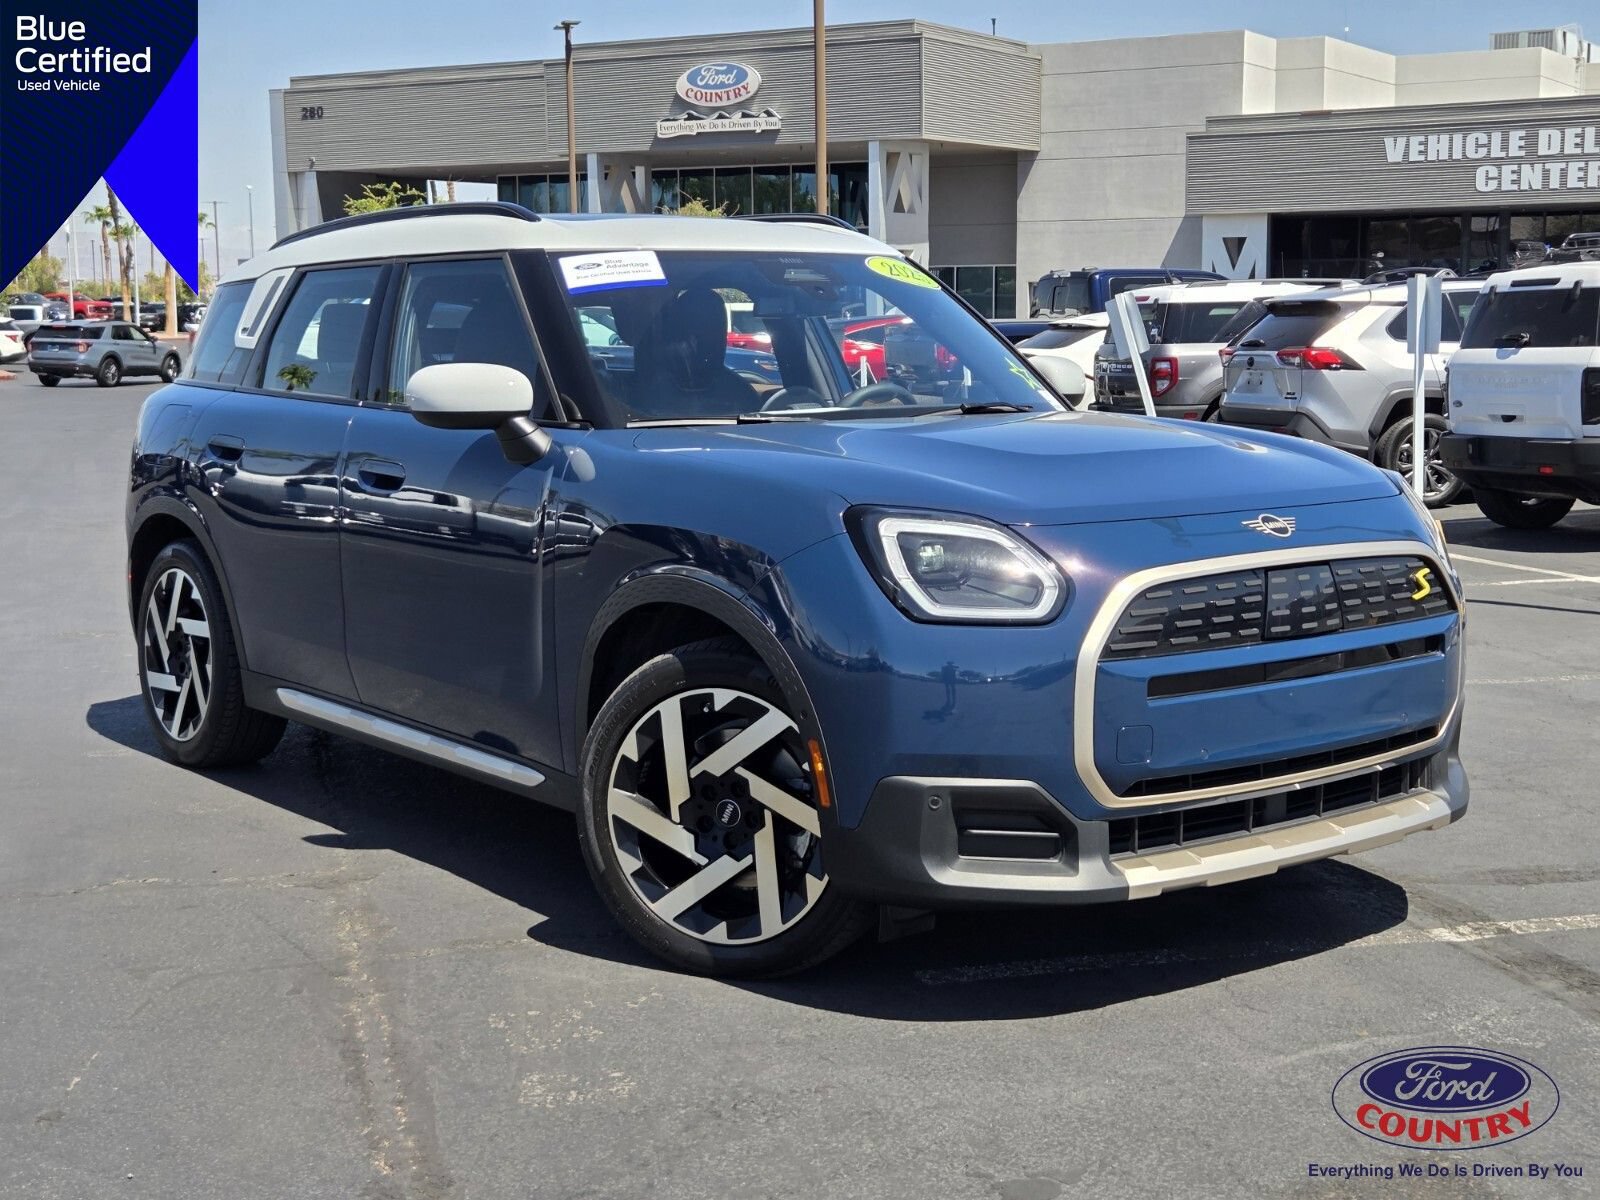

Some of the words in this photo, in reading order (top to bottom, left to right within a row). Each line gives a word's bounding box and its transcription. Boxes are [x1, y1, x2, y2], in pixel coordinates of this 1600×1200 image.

[697, 65, 737, 86] Ford
[685, 82, 751, 103] COUNTRY
[301, 106, 324, 120] 280
[660, 121, 694, 132] Everything
[696, 122, 707, 130] We
[709, 121, 719, 129] Do
[721, 120, 727, 128] Is
[728, 119, 752, 128] Driven
[753, 118, 763, 128] By
[765, 117, 778, 127] You
[1384, 130, 1526, 162] VEHICLE
[1537, 127, 1600, 156] DEL
[1264, 521, 1287, 529] MINI
[721, 803, 734, 824] MINI
